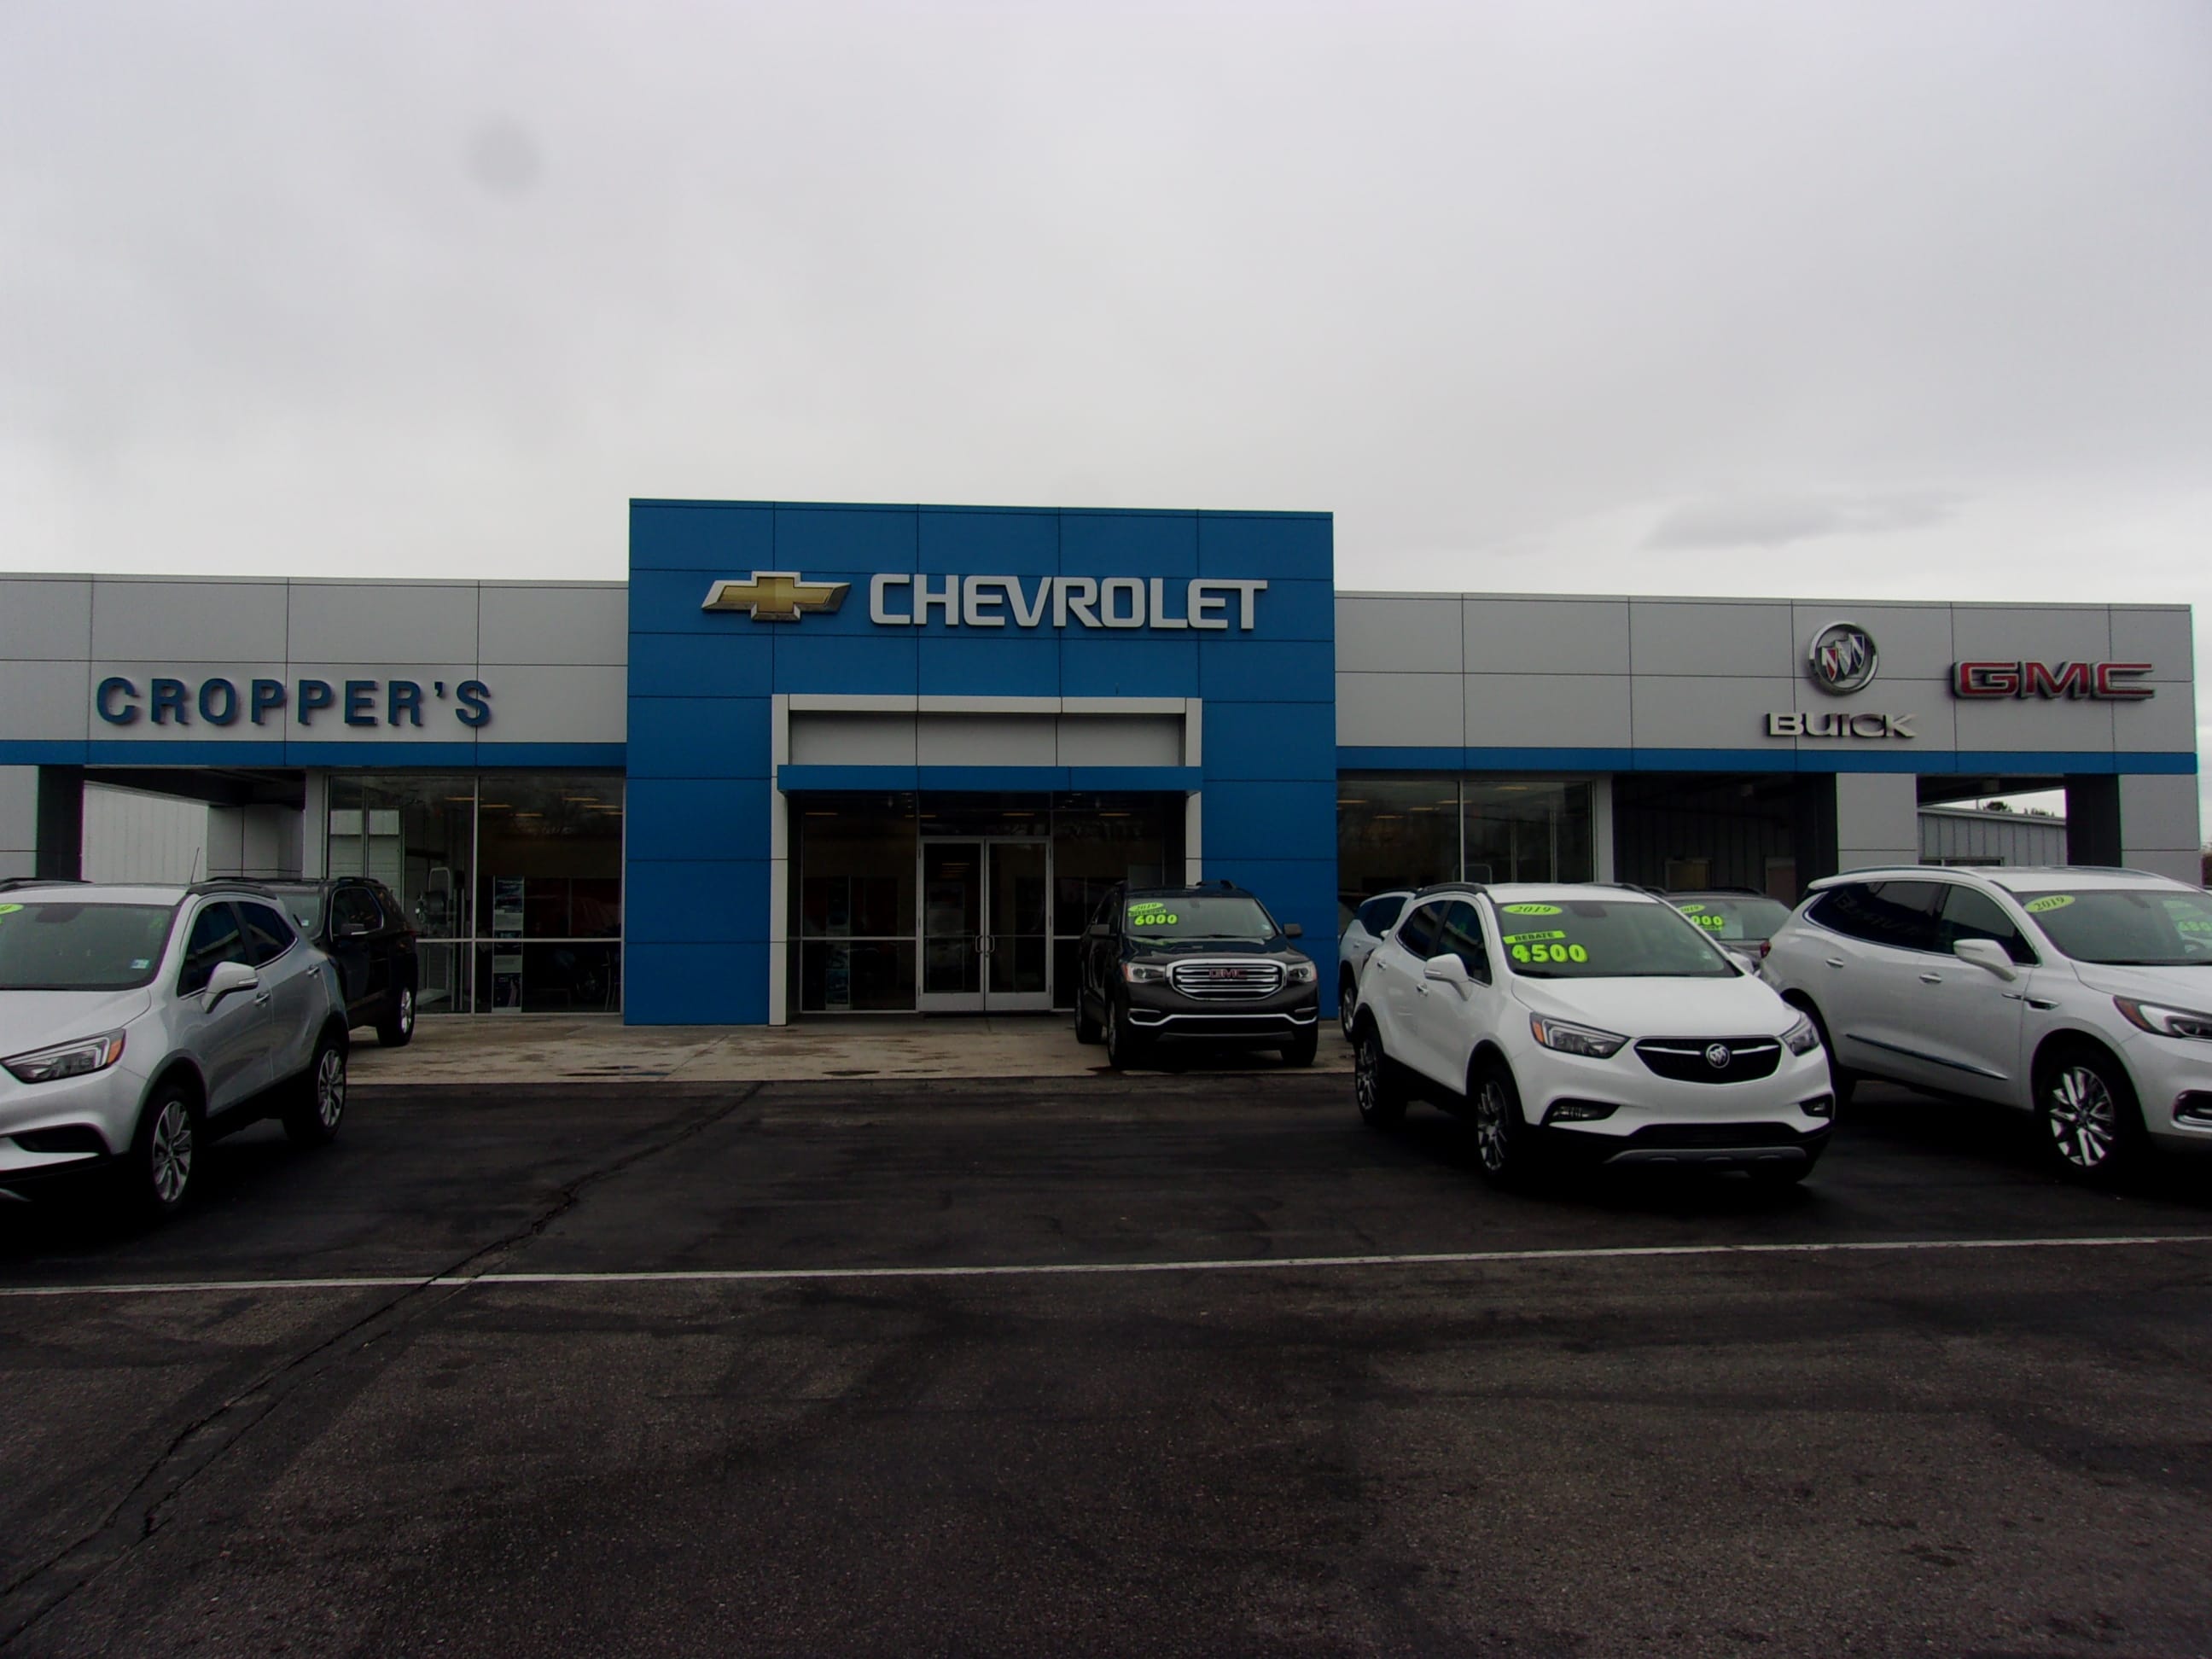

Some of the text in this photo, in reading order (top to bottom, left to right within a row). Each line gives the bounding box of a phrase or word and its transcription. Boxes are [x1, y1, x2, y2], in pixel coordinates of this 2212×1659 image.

[870, 573, 1268, 630] CHEVROLET
[1953, 660, 2155, 700] GMC
[96, 676, 493, 728] CROPPER'S
[1766, 712, 1918, 740] BUICK
[2034, 896, 2066, 911] 2019
[1133, 914, 1178, 926] 6000
[1691, 915, 1724, 926] 000
[1514, 932, 1555, 941] REBATE
[1511, 944, 1588, 963] 4500
[1208, 969, 1248, 980] GMC
